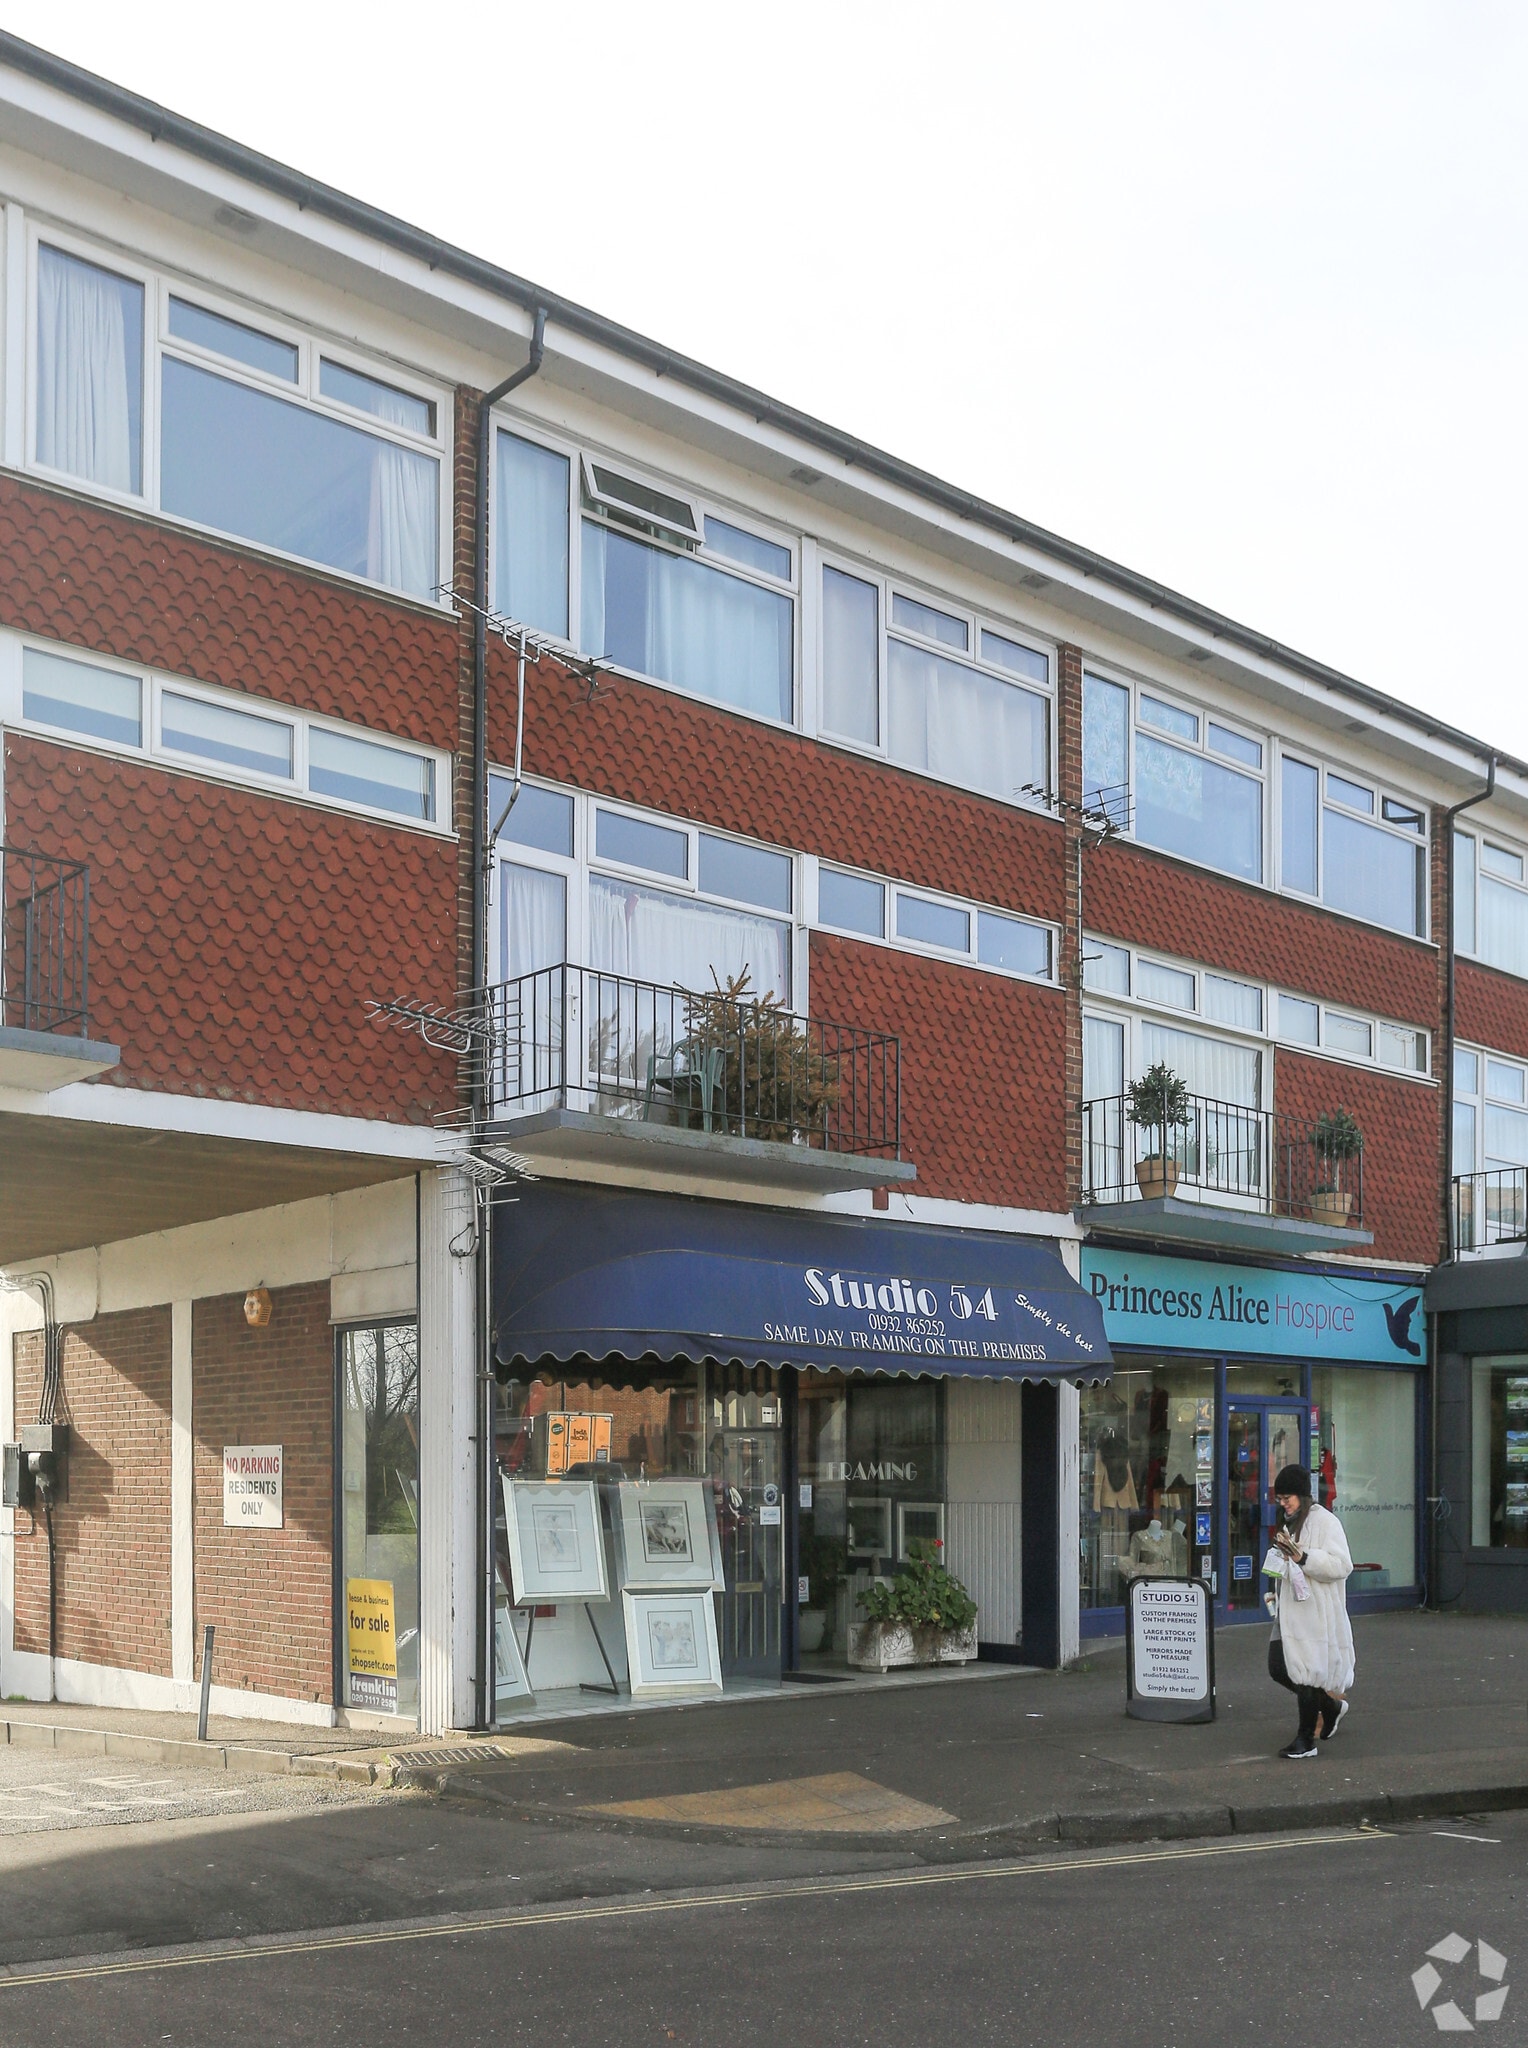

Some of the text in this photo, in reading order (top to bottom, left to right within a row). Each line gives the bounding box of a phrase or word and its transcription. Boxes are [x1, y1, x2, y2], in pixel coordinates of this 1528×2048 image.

[804, 1268, 999, 1321] Studio 54
[1089, 1271, 1354, 1339] Princess Alice Hospice
[868, 1313, 947, 1337] 01932 865252
[1014, 1294, 1093, 1352] Simply the best
[764, 1322, 1047, 1360] SAME DAY FRAMING ON THE PREMISES
[226, 1456, 279, 1474] NO PARKING
[828, 1461, 918, 1481] FRAMING
[229, 1480, 277, 1495] RESIDENTS
[241, 1501, 263, 1515] ONLY
[1142, 1593, 1195, 1603] STUDIO 54
[350, 1610, 389, 1633] for sale
[352, 1656, 396, 1672] shopsetc.com
[351, 1675, 397, 1698] franklin
[1147, 1684, 1168, 1693] Simply
[351, 1693, 363, 1703] 020
[365, 1695, 379, 1706] 7117
